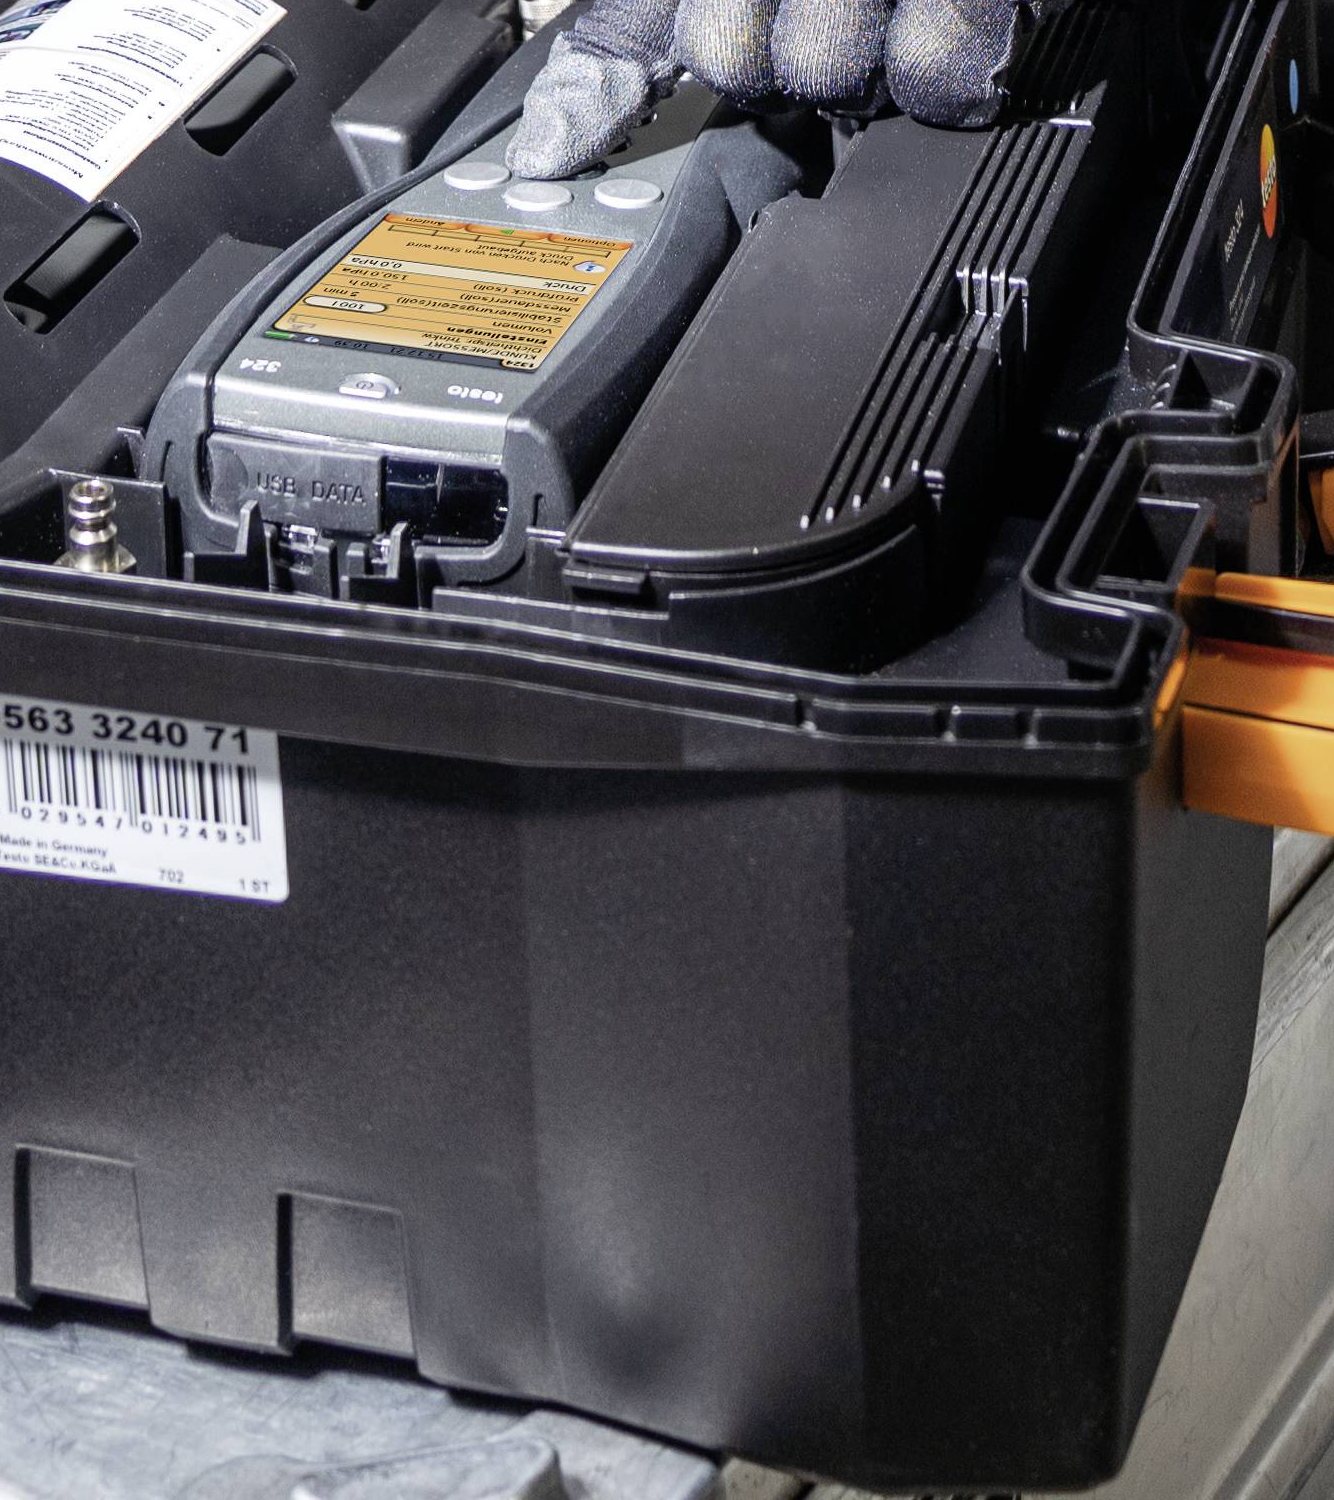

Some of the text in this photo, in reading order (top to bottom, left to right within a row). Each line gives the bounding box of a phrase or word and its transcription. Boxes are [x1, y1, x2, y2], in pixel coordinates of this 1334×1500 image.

[541, 281, 587, 291] Druck
[490, 321, 554, 333] Volumen
[423, 341, 538, 360] KUNDE/MESSORT
[240, 357, 503, 404] testo 324
[256, 471, 366, 506] USB DATA
[92, 714, 187, 748] 3240
[205, 727, 249, 754] 71
[21, 807, 123, 831] 029547
[143, 820, 246, 845] 012495
[0, 834, 108, 858] Made in Germany
